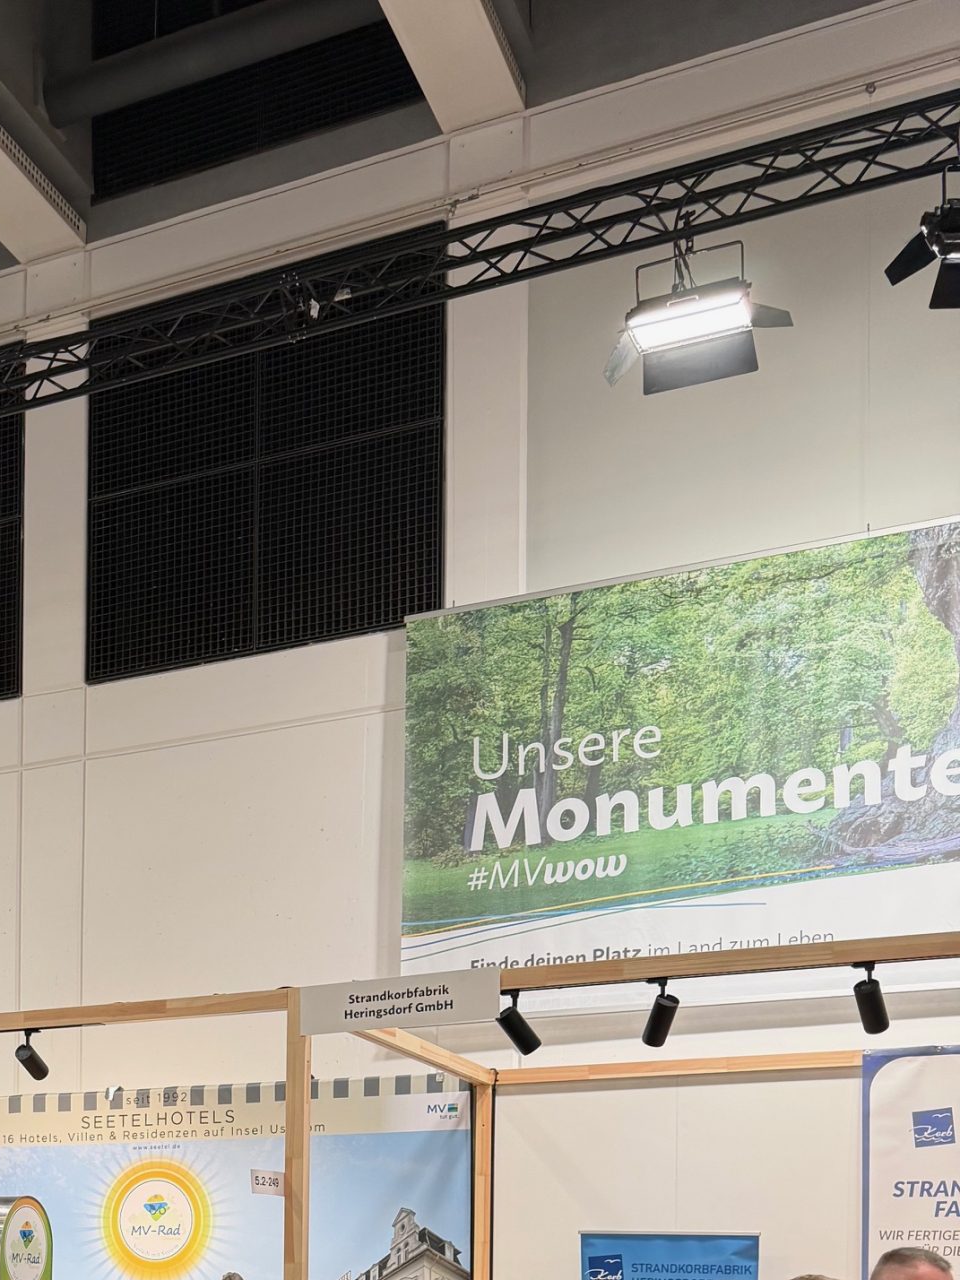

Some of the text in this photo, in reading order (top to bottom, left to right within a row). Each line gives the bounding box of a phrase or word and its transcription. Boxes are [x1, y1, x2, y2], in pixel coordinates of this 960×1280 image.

[471, 722, 663, 780] Unsere
[468, 743, 960, 852] Monumente
[466, 851, 628, 891] #MVwow
[524, 952, 586, 968] deinen
[592, 946, 642, 962] Platz
[348, 984, 450, 1005] Strandkorbfabrik
[344, 1000, 454, 1020] Heringsdorf GmbH
[126, 1091, 188, 1105] seit 1992
[427, 1104, 446, 1114] MV
[81, 1109, 236, 1129] SEETELHOTELS
[2, 1134, 15, 1144] 16
[19, 1132, 63, 1144] Hotels,
[68, 1131, 103, 1143] Villen
[109, 1130, 117, 1141] &
[123, 1128, 198, 1140] Residenzen
[203, 1126, 225, 1138] auf
[231, 1125, 263, 1137] Insel
[254, 1175, 279, 1188] 5.2-249
[130, 1223, 181, 1237] MV-Rad
[879, 1229, 904, 1241] WIR
[11, 1252, 41, 1264] MV-Rad
[631, 1262, 753, 1276] STRANDKORBFABRIK
